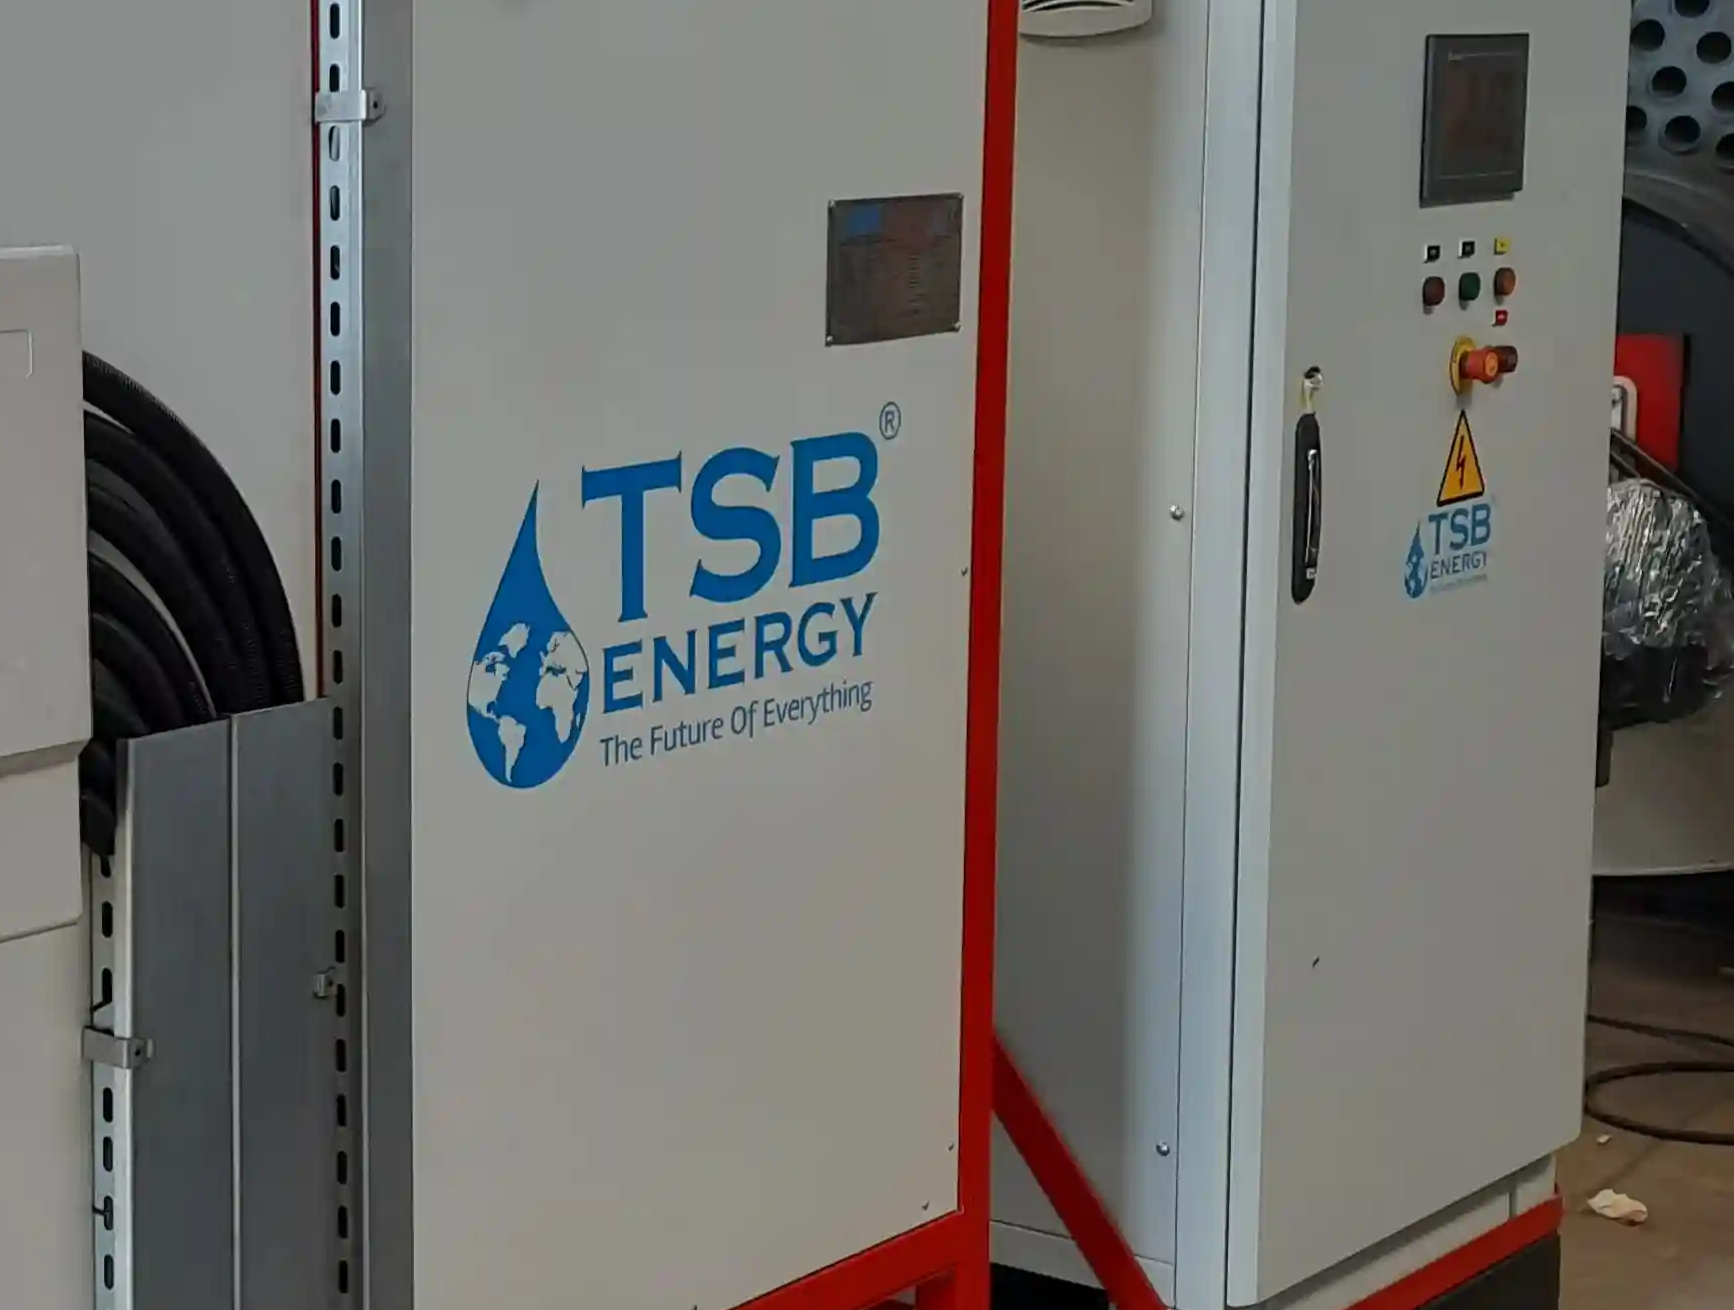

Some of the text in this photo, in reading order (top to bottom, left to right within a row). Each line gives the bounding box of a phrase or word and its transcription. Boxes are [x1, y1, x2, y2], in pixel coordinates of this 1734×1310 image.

[581, 431, 880, 622] TSB
[1428, 503, 1492, 556] TSB
[601, 592, 878, 715] ENERGY
[600, 680, 873, 767] The Future Of Everything
